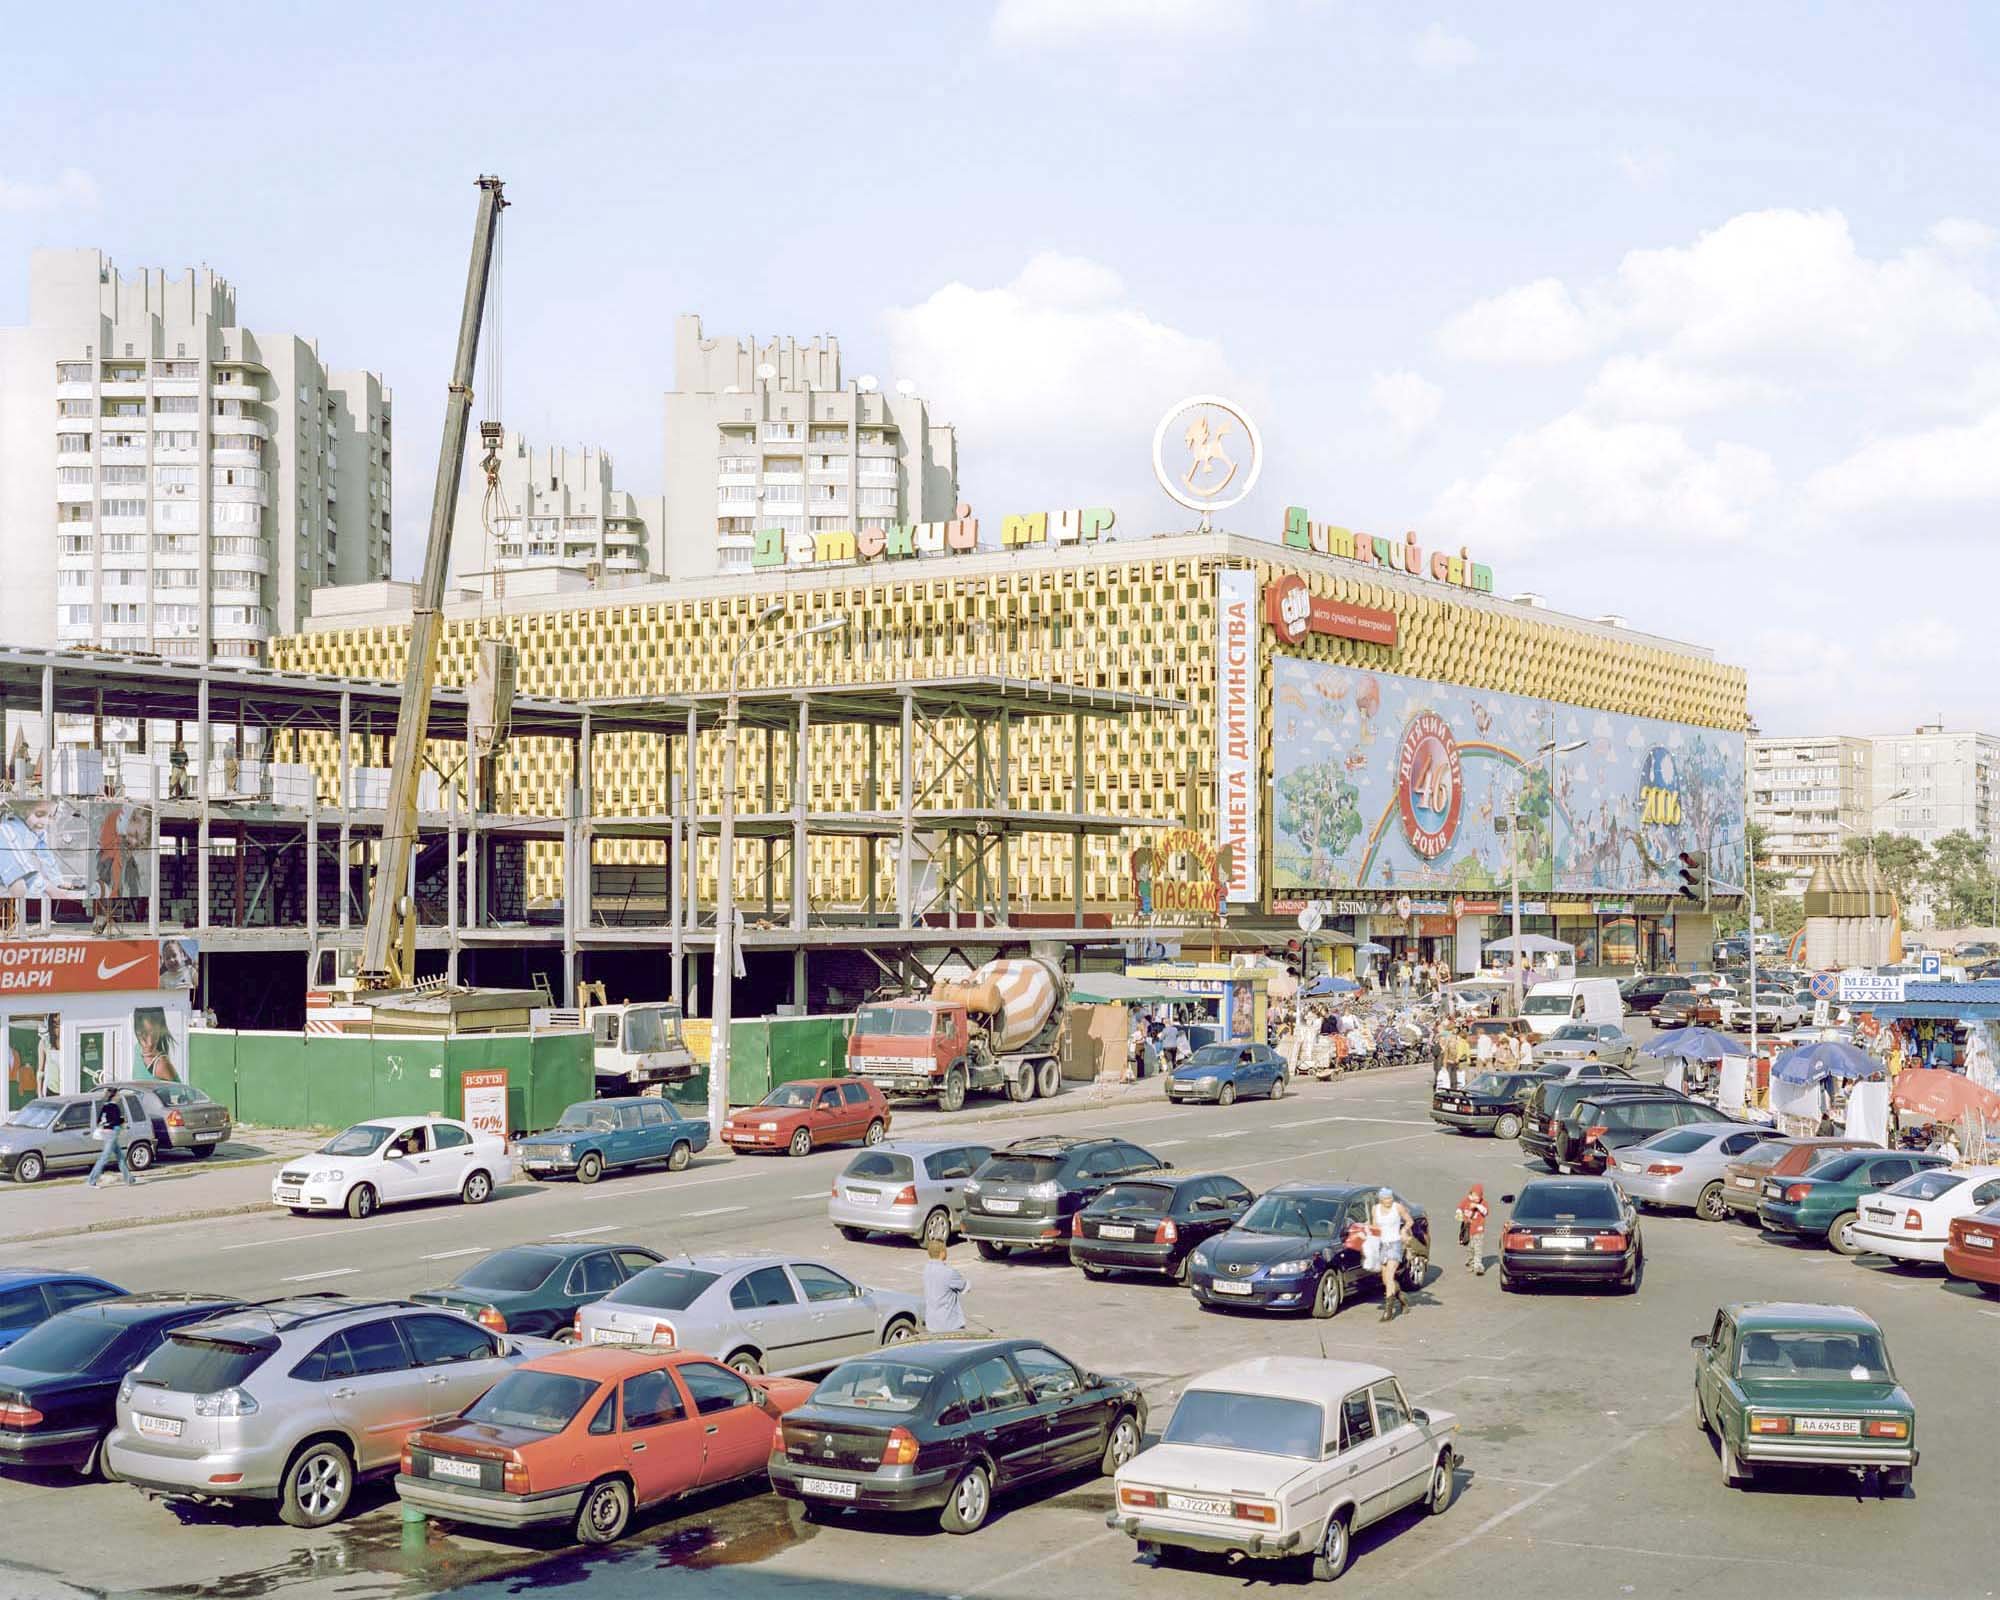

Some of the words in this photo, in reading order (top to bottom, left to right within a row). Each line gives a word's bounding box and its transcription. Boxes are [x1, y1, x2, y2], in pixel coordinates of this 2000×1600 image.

[1228, 601, 1248, 761] ДИТИНСТВА
[1413, 752, 1448, 814] 46
[1640, 785, 1681, 825] 2006
[1229, 771, 1247, 890] ПЛАНЕТА
[1412, 828, 1447, 856] РОКІВ
[1153, 881, 1216, 910] ПАСАЖ
[0, 947, 86, 966] ОРТИВНІ
[0, 970, 53, 989] ВАРИ
[1844, 977, 1899, 987] МЕБЛІ
[1844, 990, 1899, 1001] КУХНІ
[466, 1075, 503, 1086] ВЗУТТЯ
[471, 1114, 503, 1130] 50%
[1802, 1420, 1816, 1430] AA
[1818, 1422, 1841, 1431] 6943
[1843, 1422, 1857, 1432] BE
